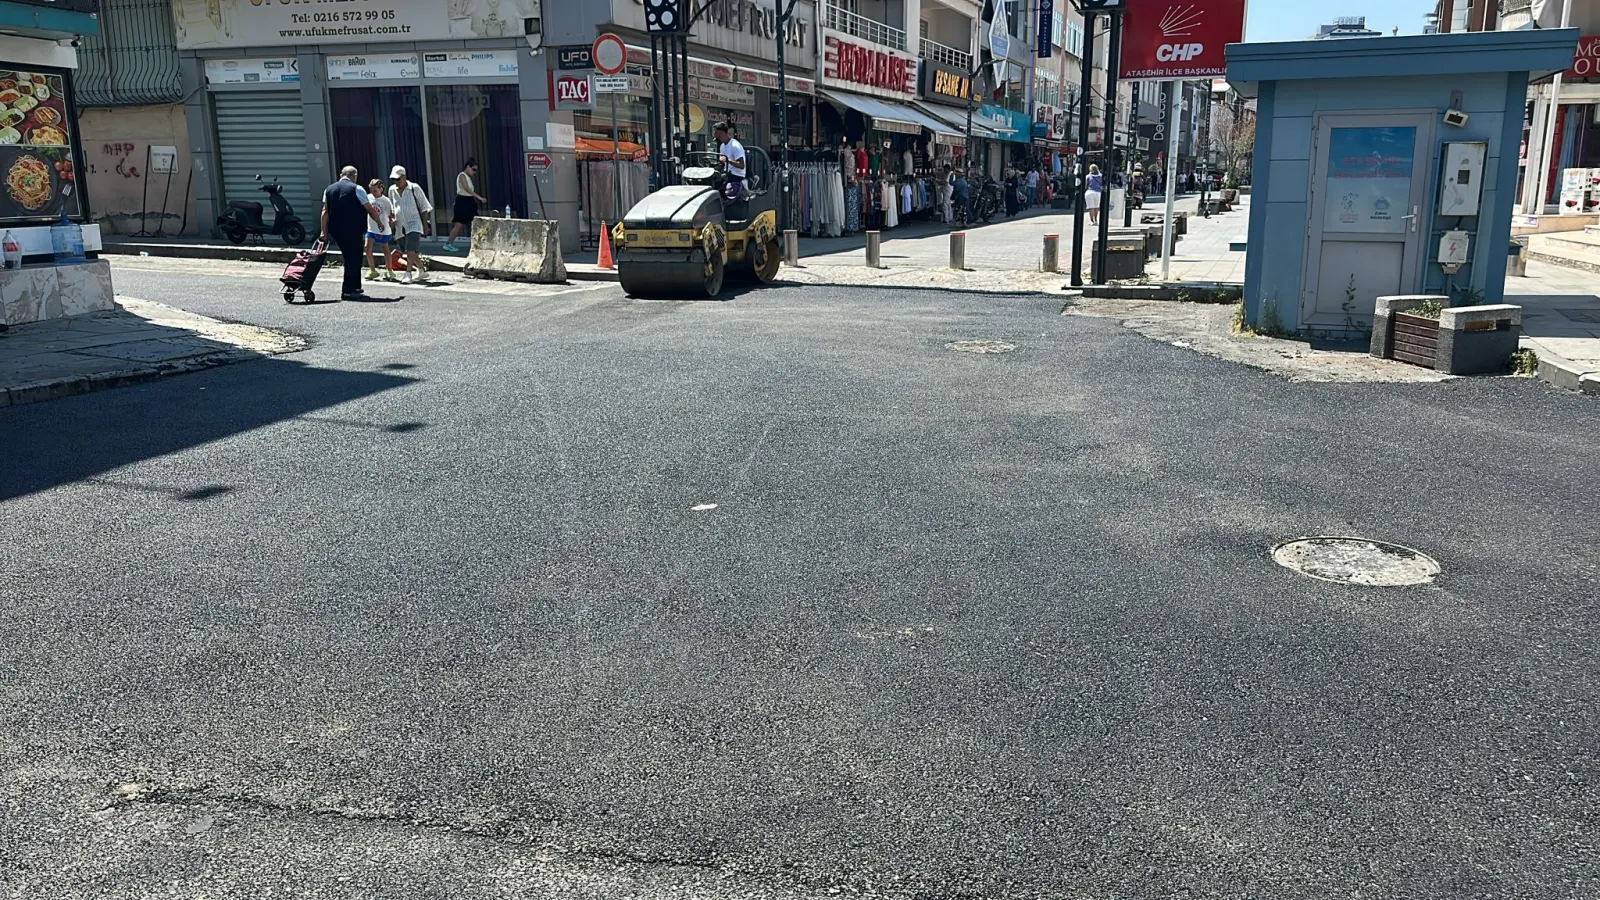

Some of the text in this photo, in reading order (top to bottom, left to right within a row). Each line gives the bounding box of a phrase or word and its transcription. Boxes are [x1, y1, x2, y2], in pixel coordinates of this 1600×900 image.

[291, 10, 395, 23] Tel: 0216 572 99 05
[279, 24, 411, 37] www.ufukmefrusat.com.tr
[561, 51, 589, 62] UFO
[1156, 43, 1204, 62] CHP
[1126, 67, 1164, 77] ATAŞEHİR
[1165, 67, 1183, 76] İLÇE
[558, 80, 587, 101] TAÇ
